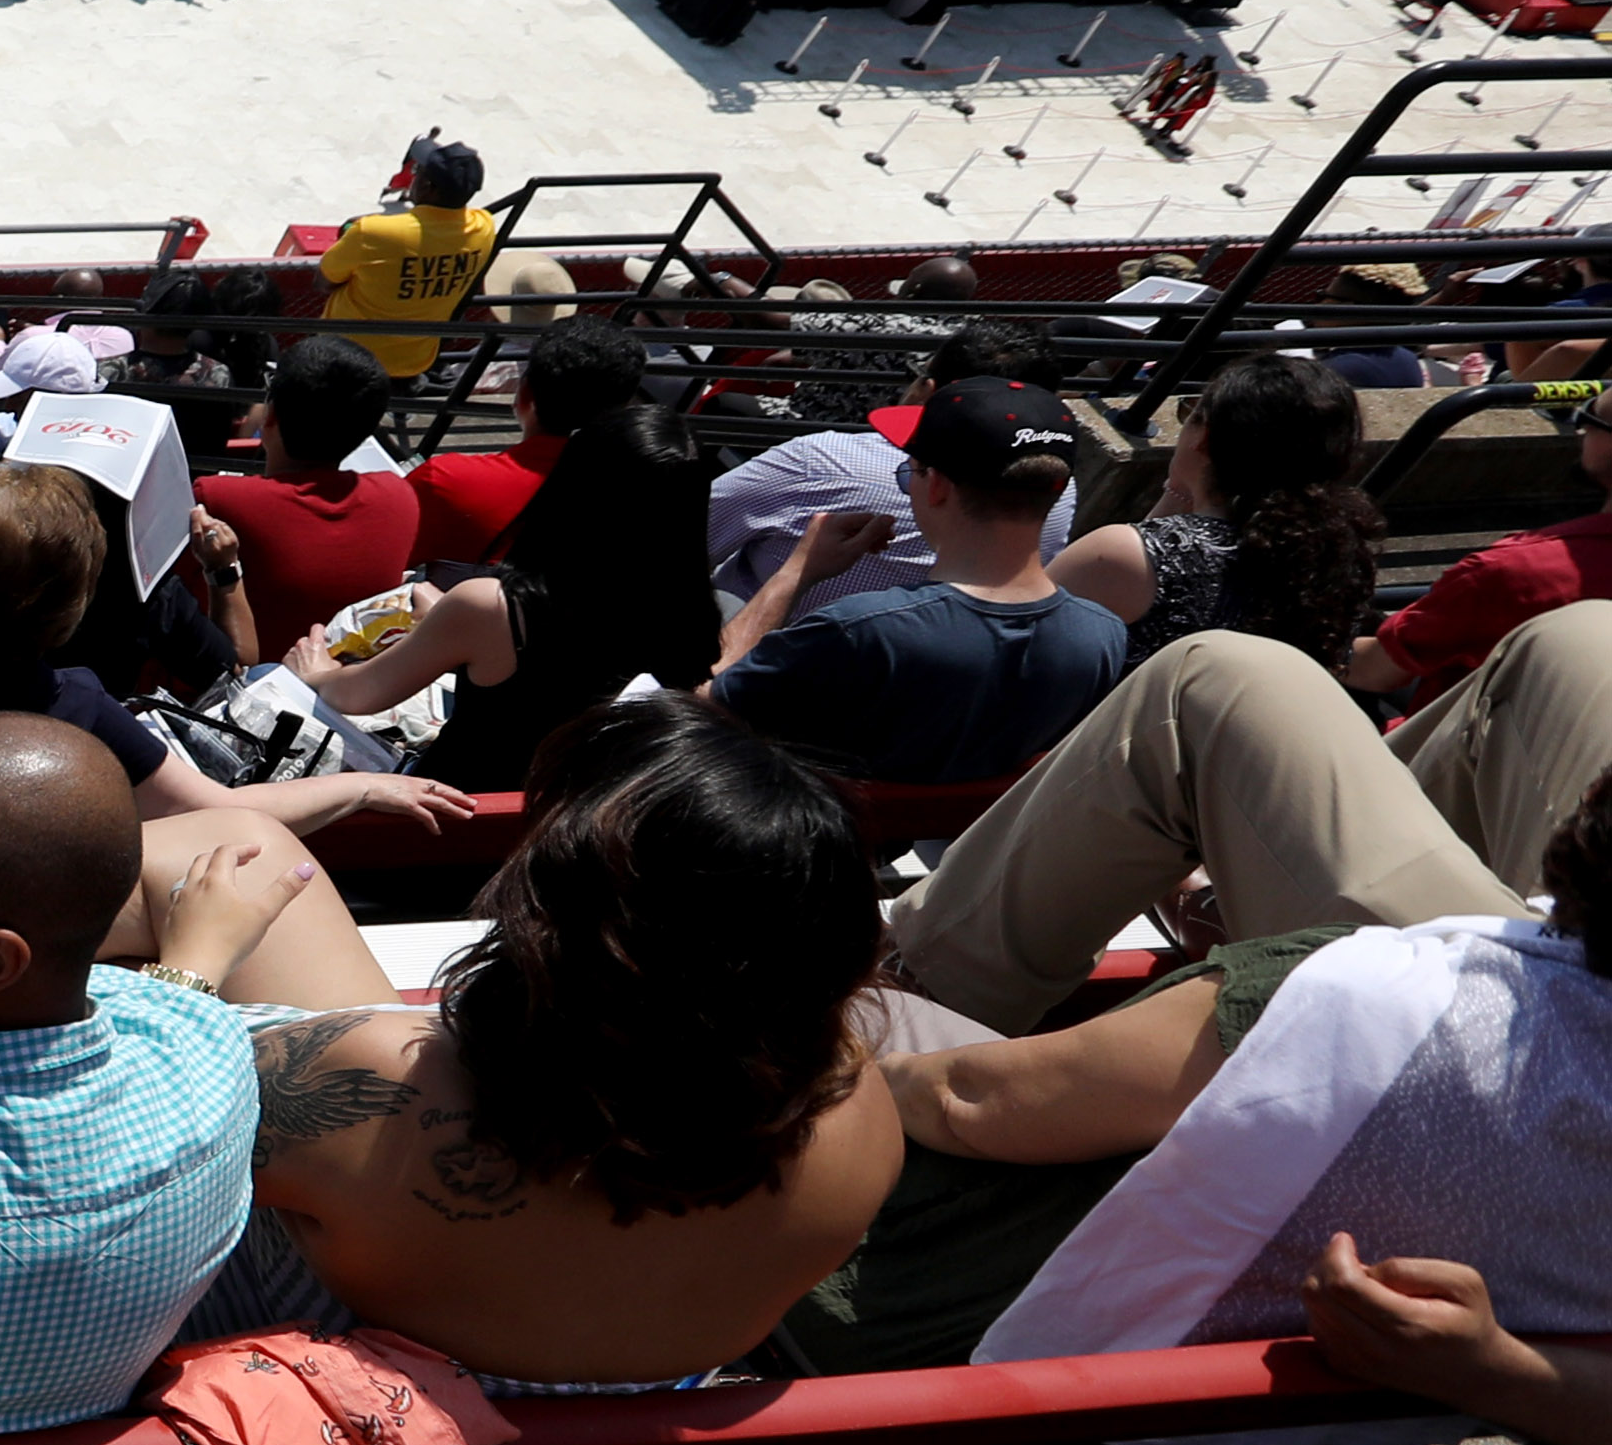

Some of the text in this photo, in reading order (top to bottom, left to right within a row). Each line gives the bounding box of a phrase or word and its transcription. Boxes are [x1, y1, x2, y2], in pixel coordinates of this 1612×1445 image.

[400, 249, 482, 278] EVENT
[397, 272, 474, 300] STAFF
[1010, 428, 1074, 447] Rutgers
